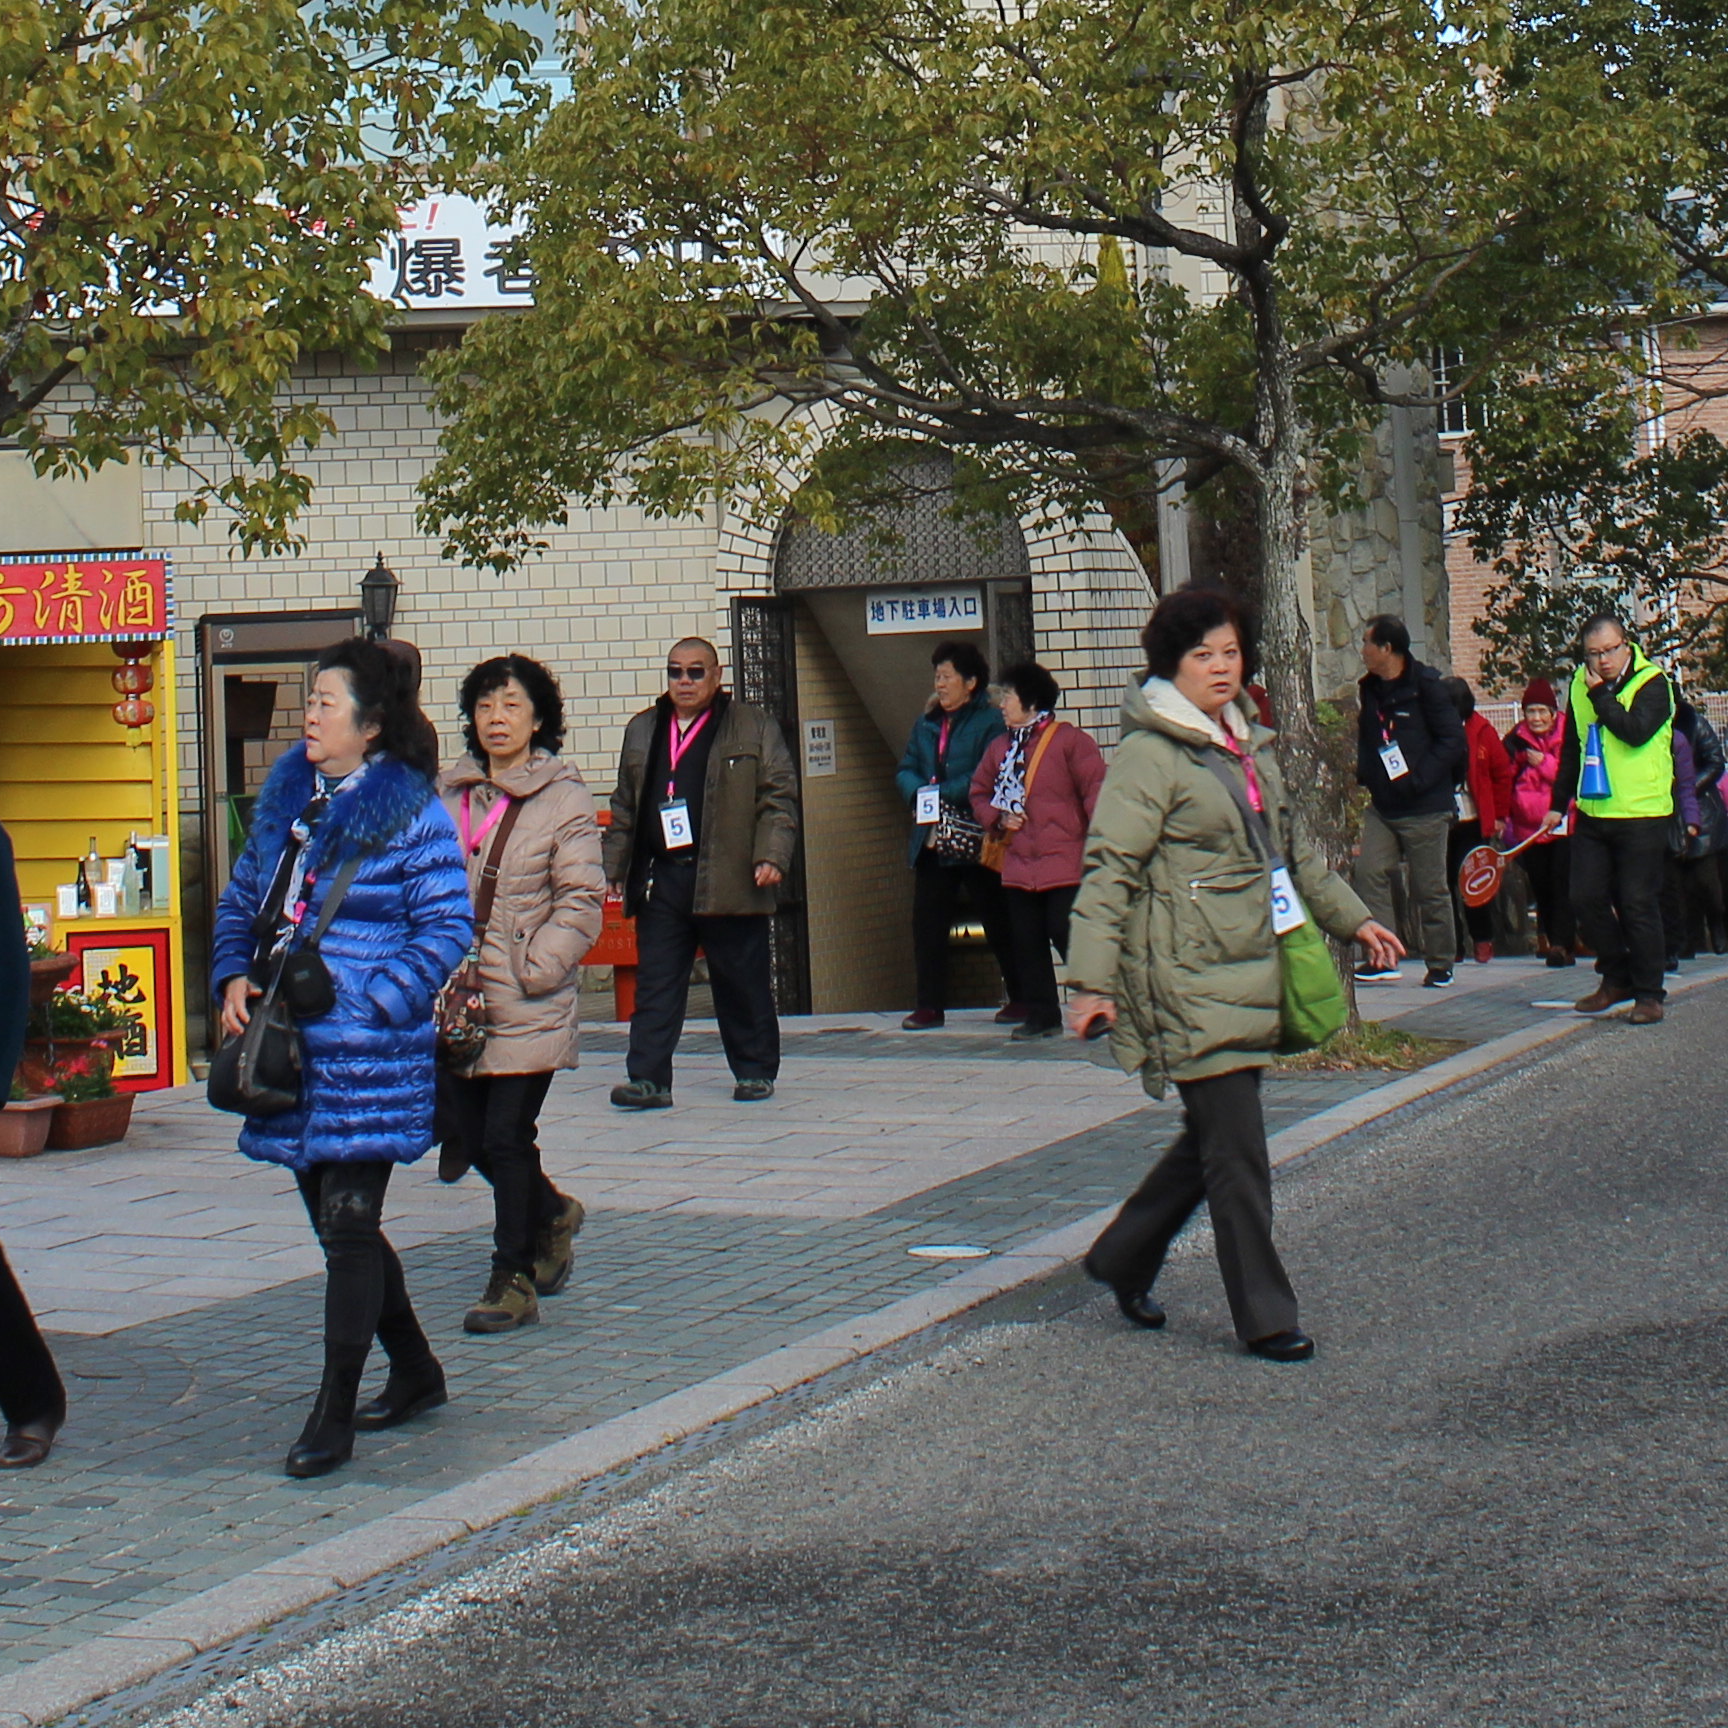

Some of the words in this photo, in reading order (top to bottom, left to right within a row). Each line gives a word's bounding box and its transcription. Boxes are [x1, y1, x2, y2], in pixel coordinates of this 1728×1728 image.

[870, 596, 978, 622] 地下駐車場入口
[1389, 755, 1400, 770] 5
[923, 799, 934, 815] 5
[670, 816, 684, 837] 5
[1271, 885, 1290, 914] 5
